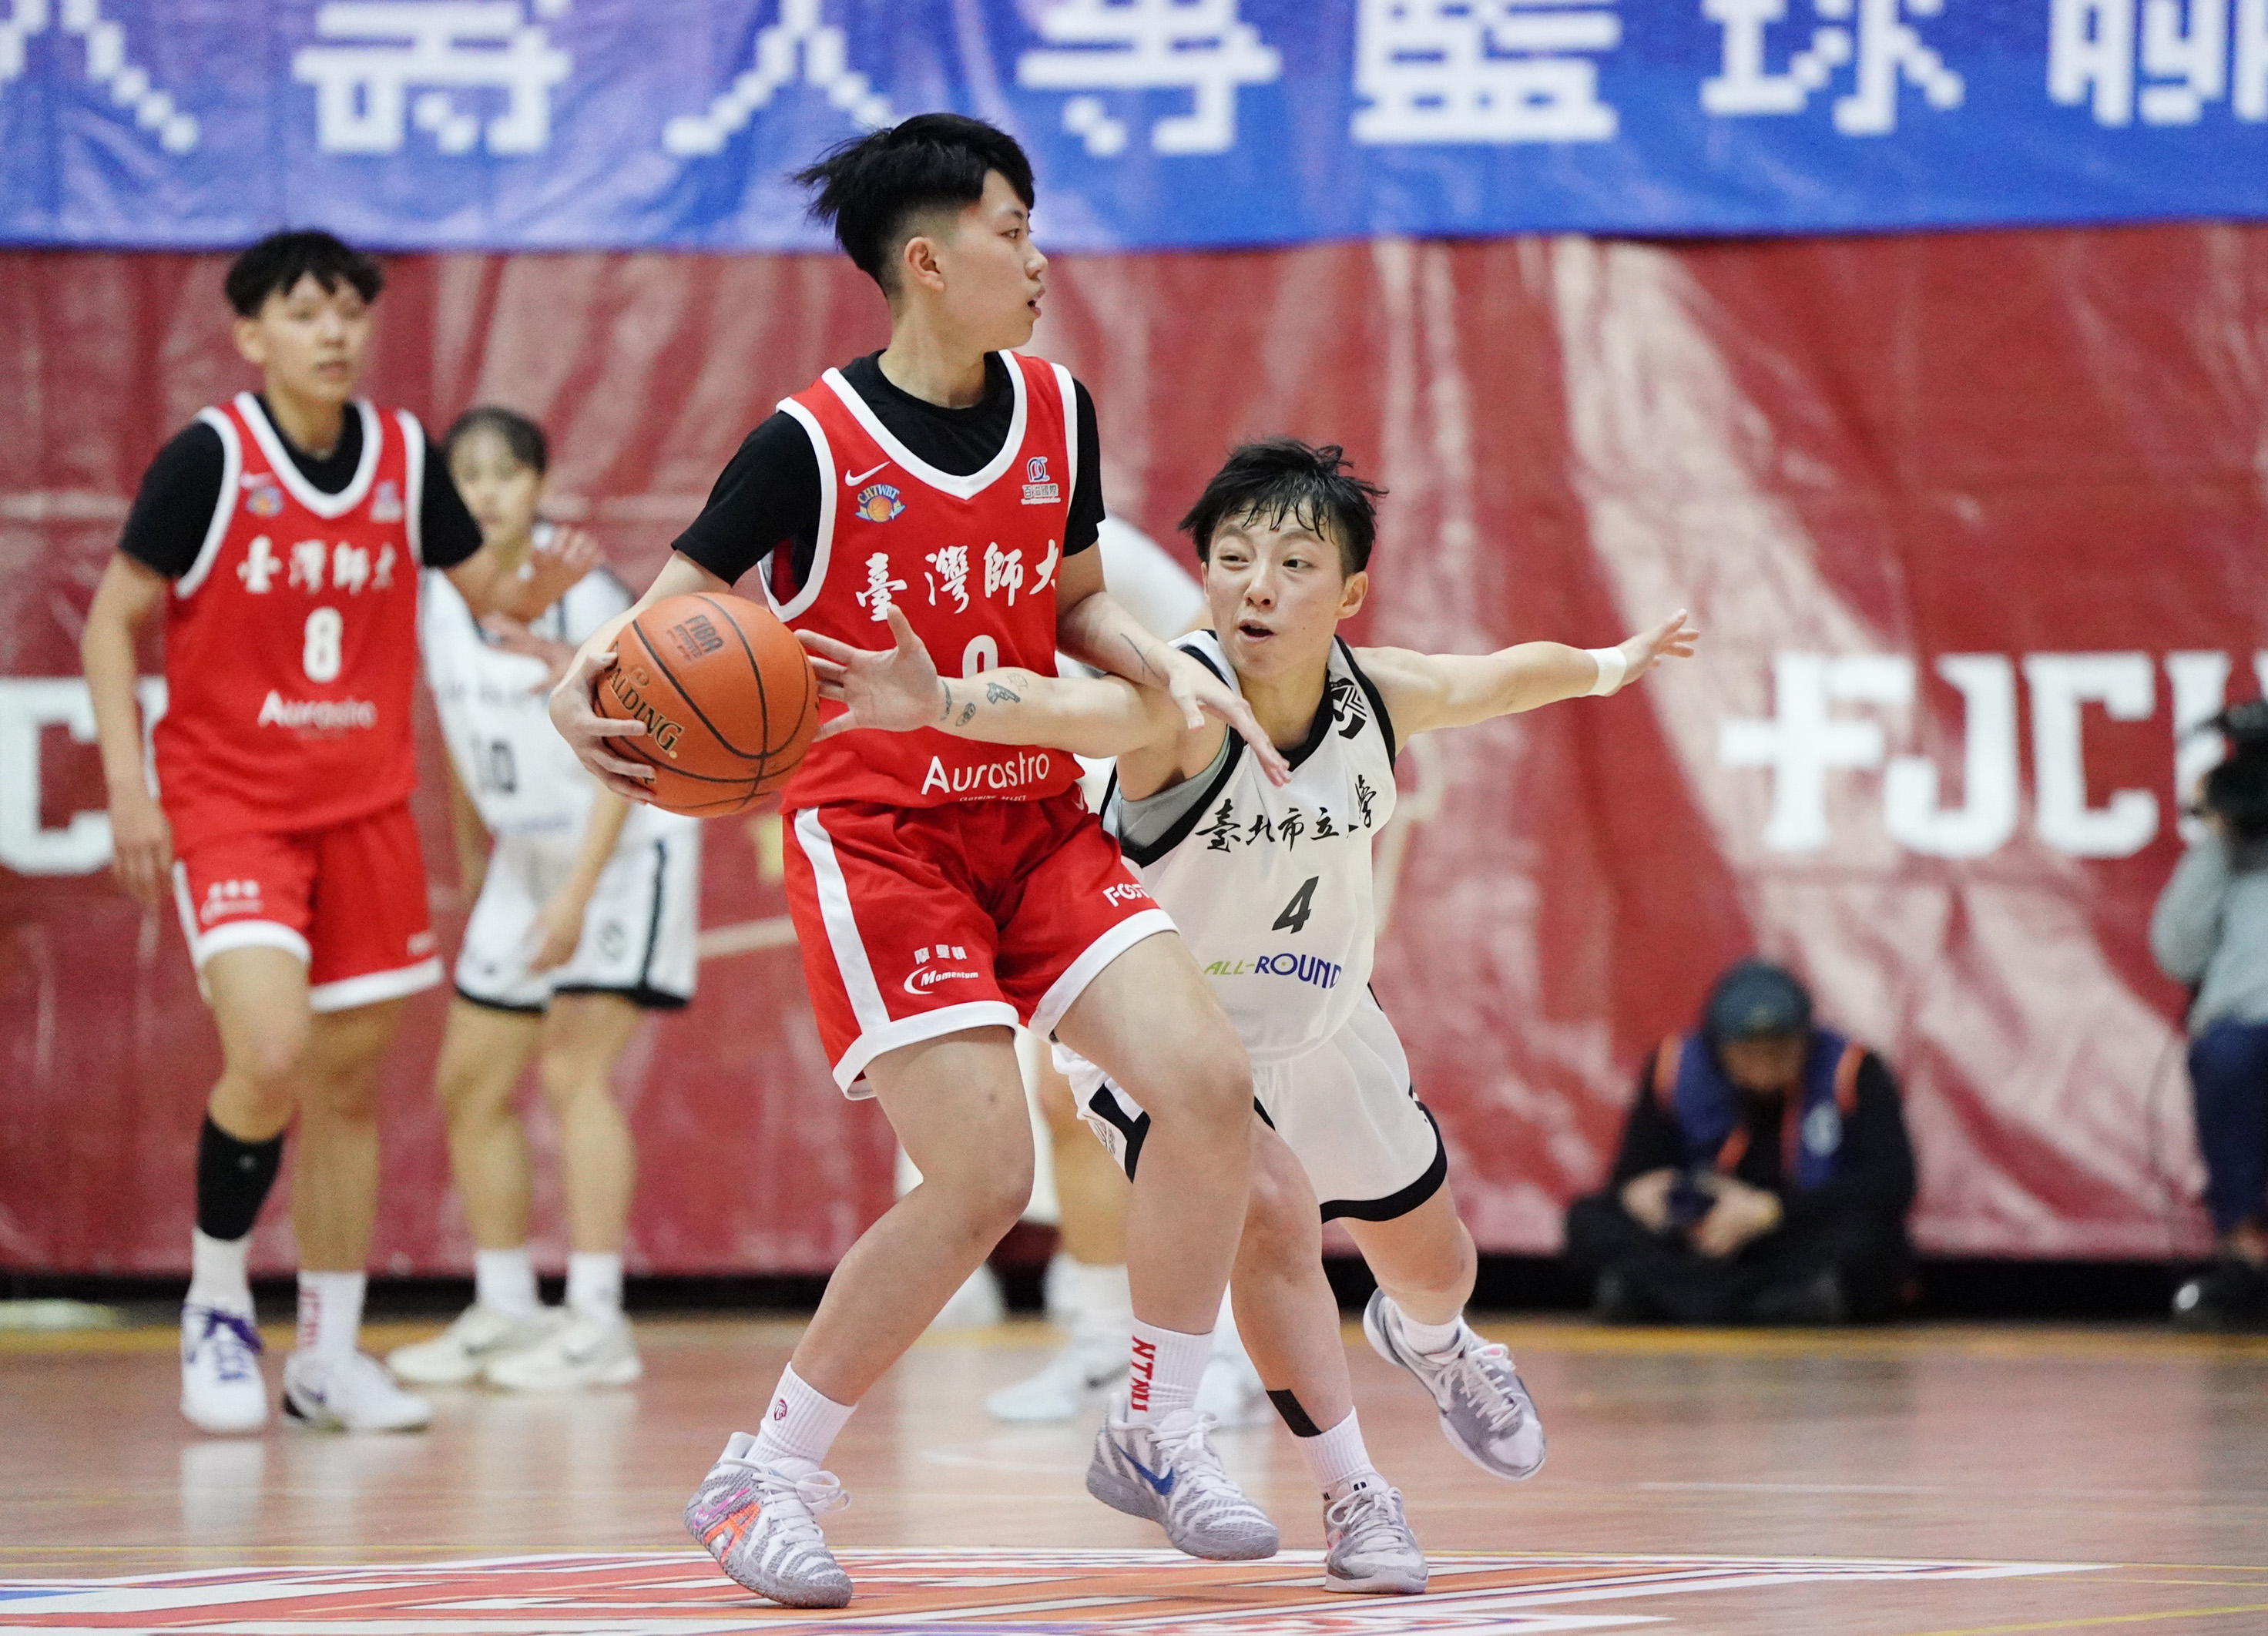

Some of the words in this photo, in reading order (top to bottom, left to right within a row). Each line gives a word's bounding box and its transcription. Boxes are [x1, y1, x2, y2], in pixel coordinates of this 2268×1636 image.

[303, 606, 344, 683] 8
[921, 751, 1050, 795] Aurastro
[1195, 775, 1377, 853] 臺北市立學
[1271, 875, 1320, 934] 4
[920, 970, 979, 987] Momentum
[1130, 1335, 1156, 1413] NTNU
